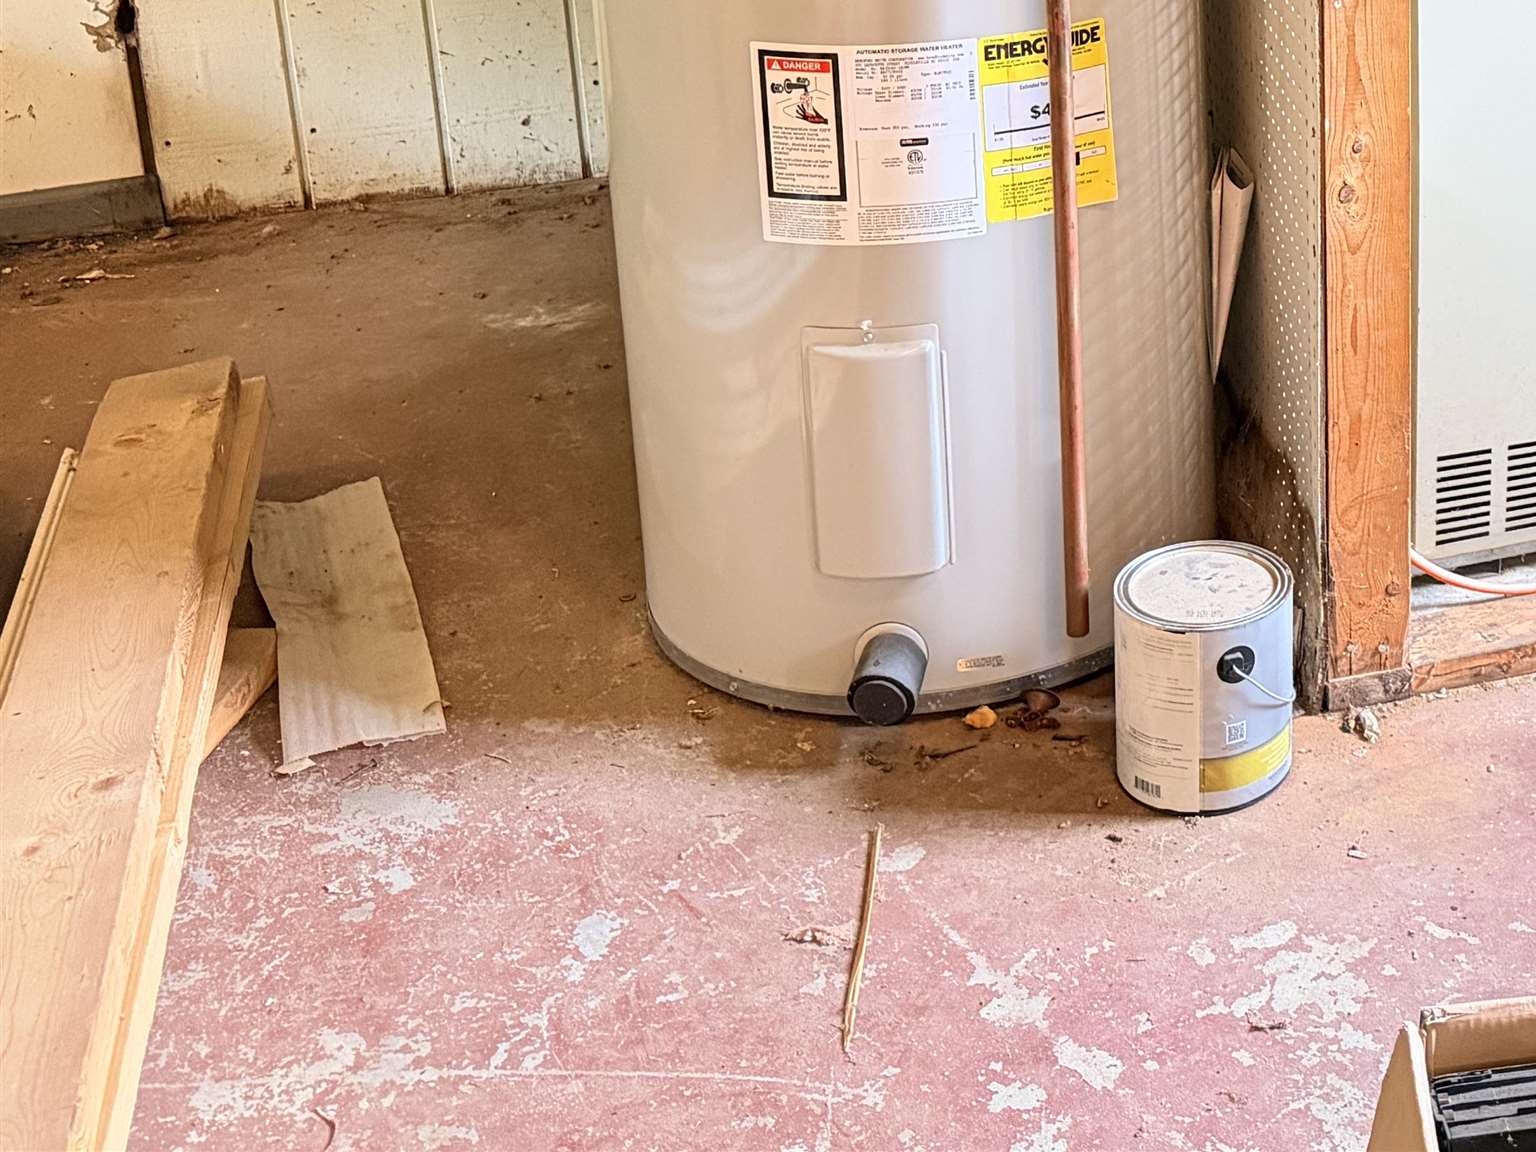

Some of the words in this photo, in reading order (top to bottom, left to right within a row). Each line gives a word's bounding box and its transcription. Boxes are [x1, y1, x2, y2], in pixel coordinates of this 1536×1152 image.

[940, 43, 963, 51] HEATER
[782, 61, 821, 71] DANGER
[1030, 102, 1050, 119] $4
